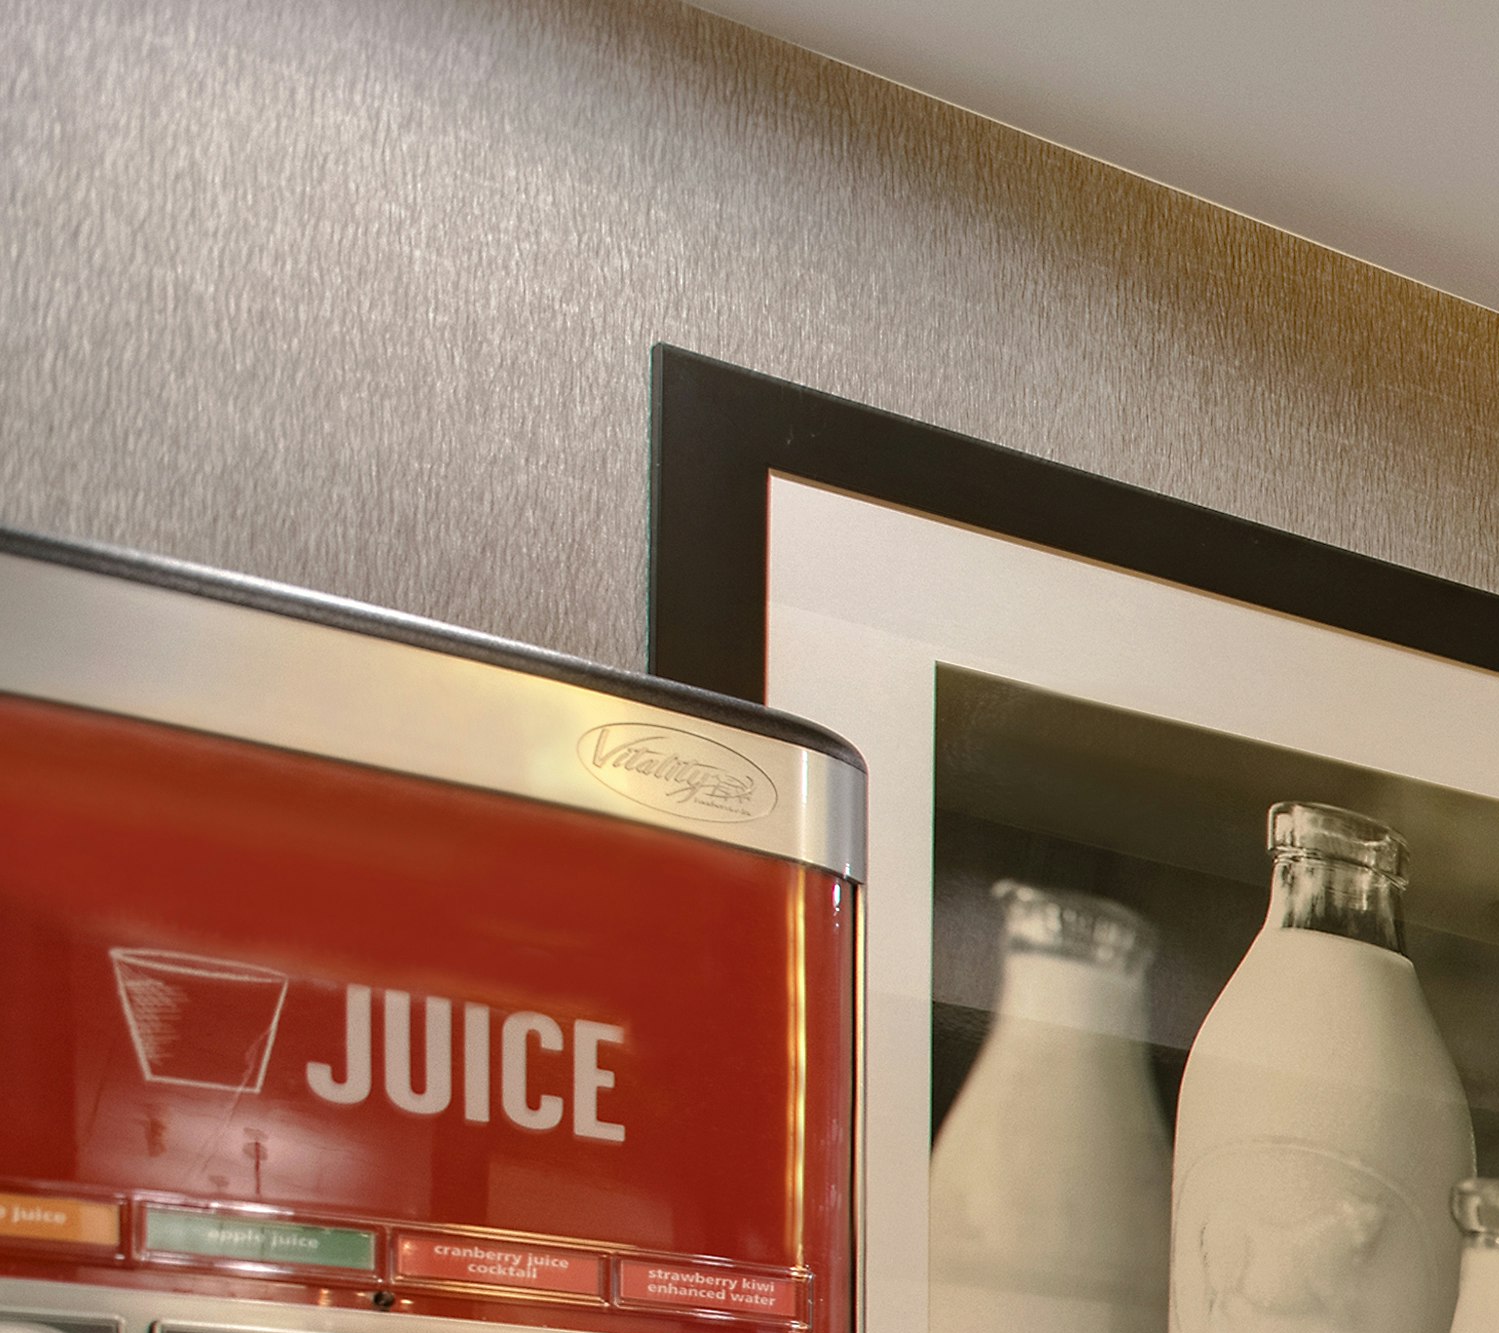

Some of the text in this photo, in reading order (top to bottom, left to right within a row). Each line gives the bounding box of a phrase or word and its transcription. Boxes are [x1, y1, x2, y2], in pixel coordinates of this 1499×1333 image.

[306, 982, 626, 1144] JUICE
[11, 1204, 67, 1226] juice
[208, 1229, 320, 1250] apple juice
[434, 1243, 570, 1269] cranberry juice
[467, 1262, 537, 1280] cocktail
[648, 1267, 775, 1293] strawberry kiwi
[647, 1281, 776, 1306] enhanced water
